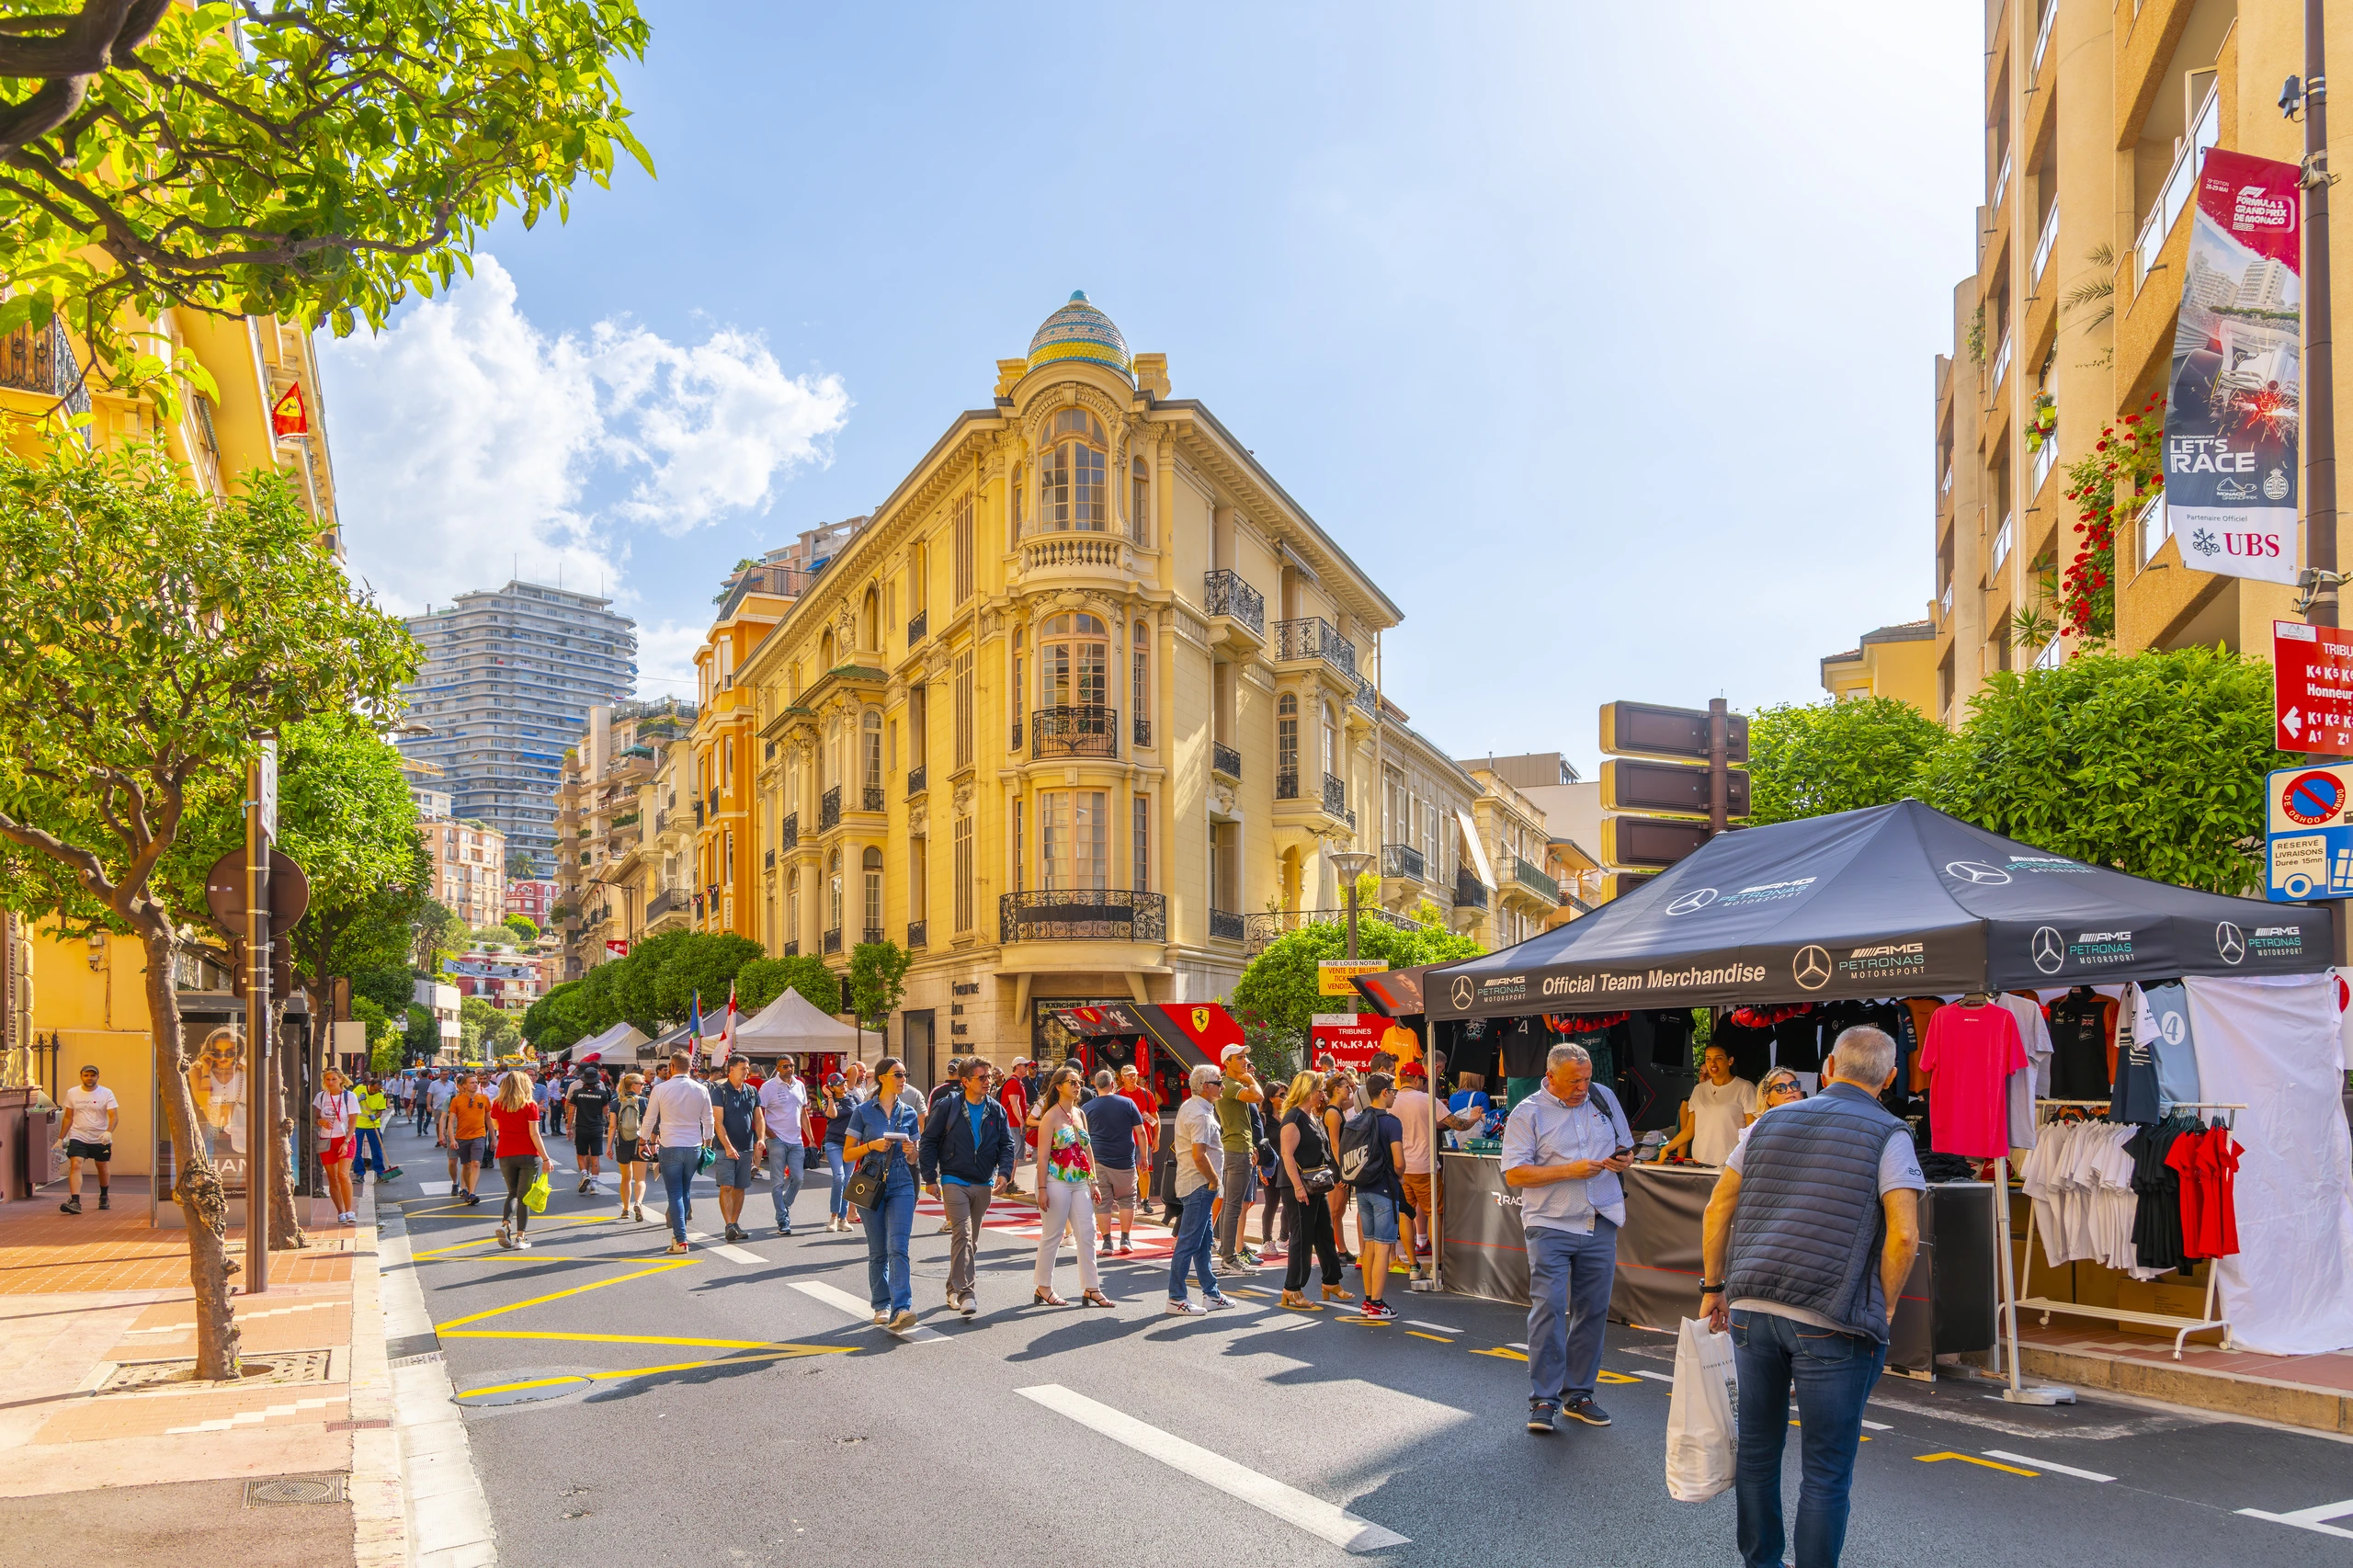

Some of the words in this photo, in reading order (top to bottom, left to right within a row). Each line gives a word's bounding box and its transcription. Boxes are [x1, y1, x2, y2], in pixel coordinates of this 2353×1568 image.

[2236, 196, 2276, 209] FORMULA
[2234, 205, 2265, 214] GRAND
[2266, 209, 2287, 217] PRIX
[2234, 213, 2245, 222] DE
[2245, 215, 2285, 225] MONACO
[2170, 438, 2228, 454] LET'S
[2170, 452, 2256, 473] RACE
[2222, 532, 2280, 557] UBS
[2323, 642, 2353, 656] TRIBU
[2306, 665, 2322, 678] K4
[2324, 667, 2339, 680] K5
[2307, 683, 2353, 700] Honneur
[2307, 711, 2322, 725] K1
[2325, 713, 2340, 726] K2
[2308, 730, 2322, 743] A1
[2337, 733, 2349, 745] Z1
[2284, 795, 2291, 806] DE
[2289, 810, 2321, 824] 06H00
[2333, 789, 2345, 811] 18H00
[2275, 848, 2324, 858] LIVRAISONS
[2005, 862, 2086, 871] PETRONAS
[1769, 876, 1818, 889] AMG
[1717, 884, 1810, 903] PETRONAS
[1722, 892, 1801, 907] MOTORSPORT
[2096, 931, 2131, 942] AMG
[2270, 926, 2300, 936] AMG
[2069, 942, 2132, 955] PETRONAS
[2247, 937, 2302, 948] PETRONAS
[1872, 943, 1924, 956] AMG
[2257, 948, 2302, 956] MOTORSPORT
[1838, 954, 1925, 971] PETRONAS
[2079, 954, 2134, 964] MOTORSPORT
[1542, 975, 1595, 995] Official
[1599, 971, 1643, 992] Team
[1647, 963, 1766, 989] Merchandise
[1851, 966, 1925, 979] MOTORSPORT
[1498, 976, 1526, 985] AMG
[1477, 984, 1526, 996] PETRONAS
[1483, 994, 1526, 1003] MOTORSPORT
[1518, 1019, 1529, 1035] 4
[2165, 1016, 2178, 1041] 4
[1343, 1144, 1369, 1172] NIKE
[1908, 1166, 1922, 1176] 20
